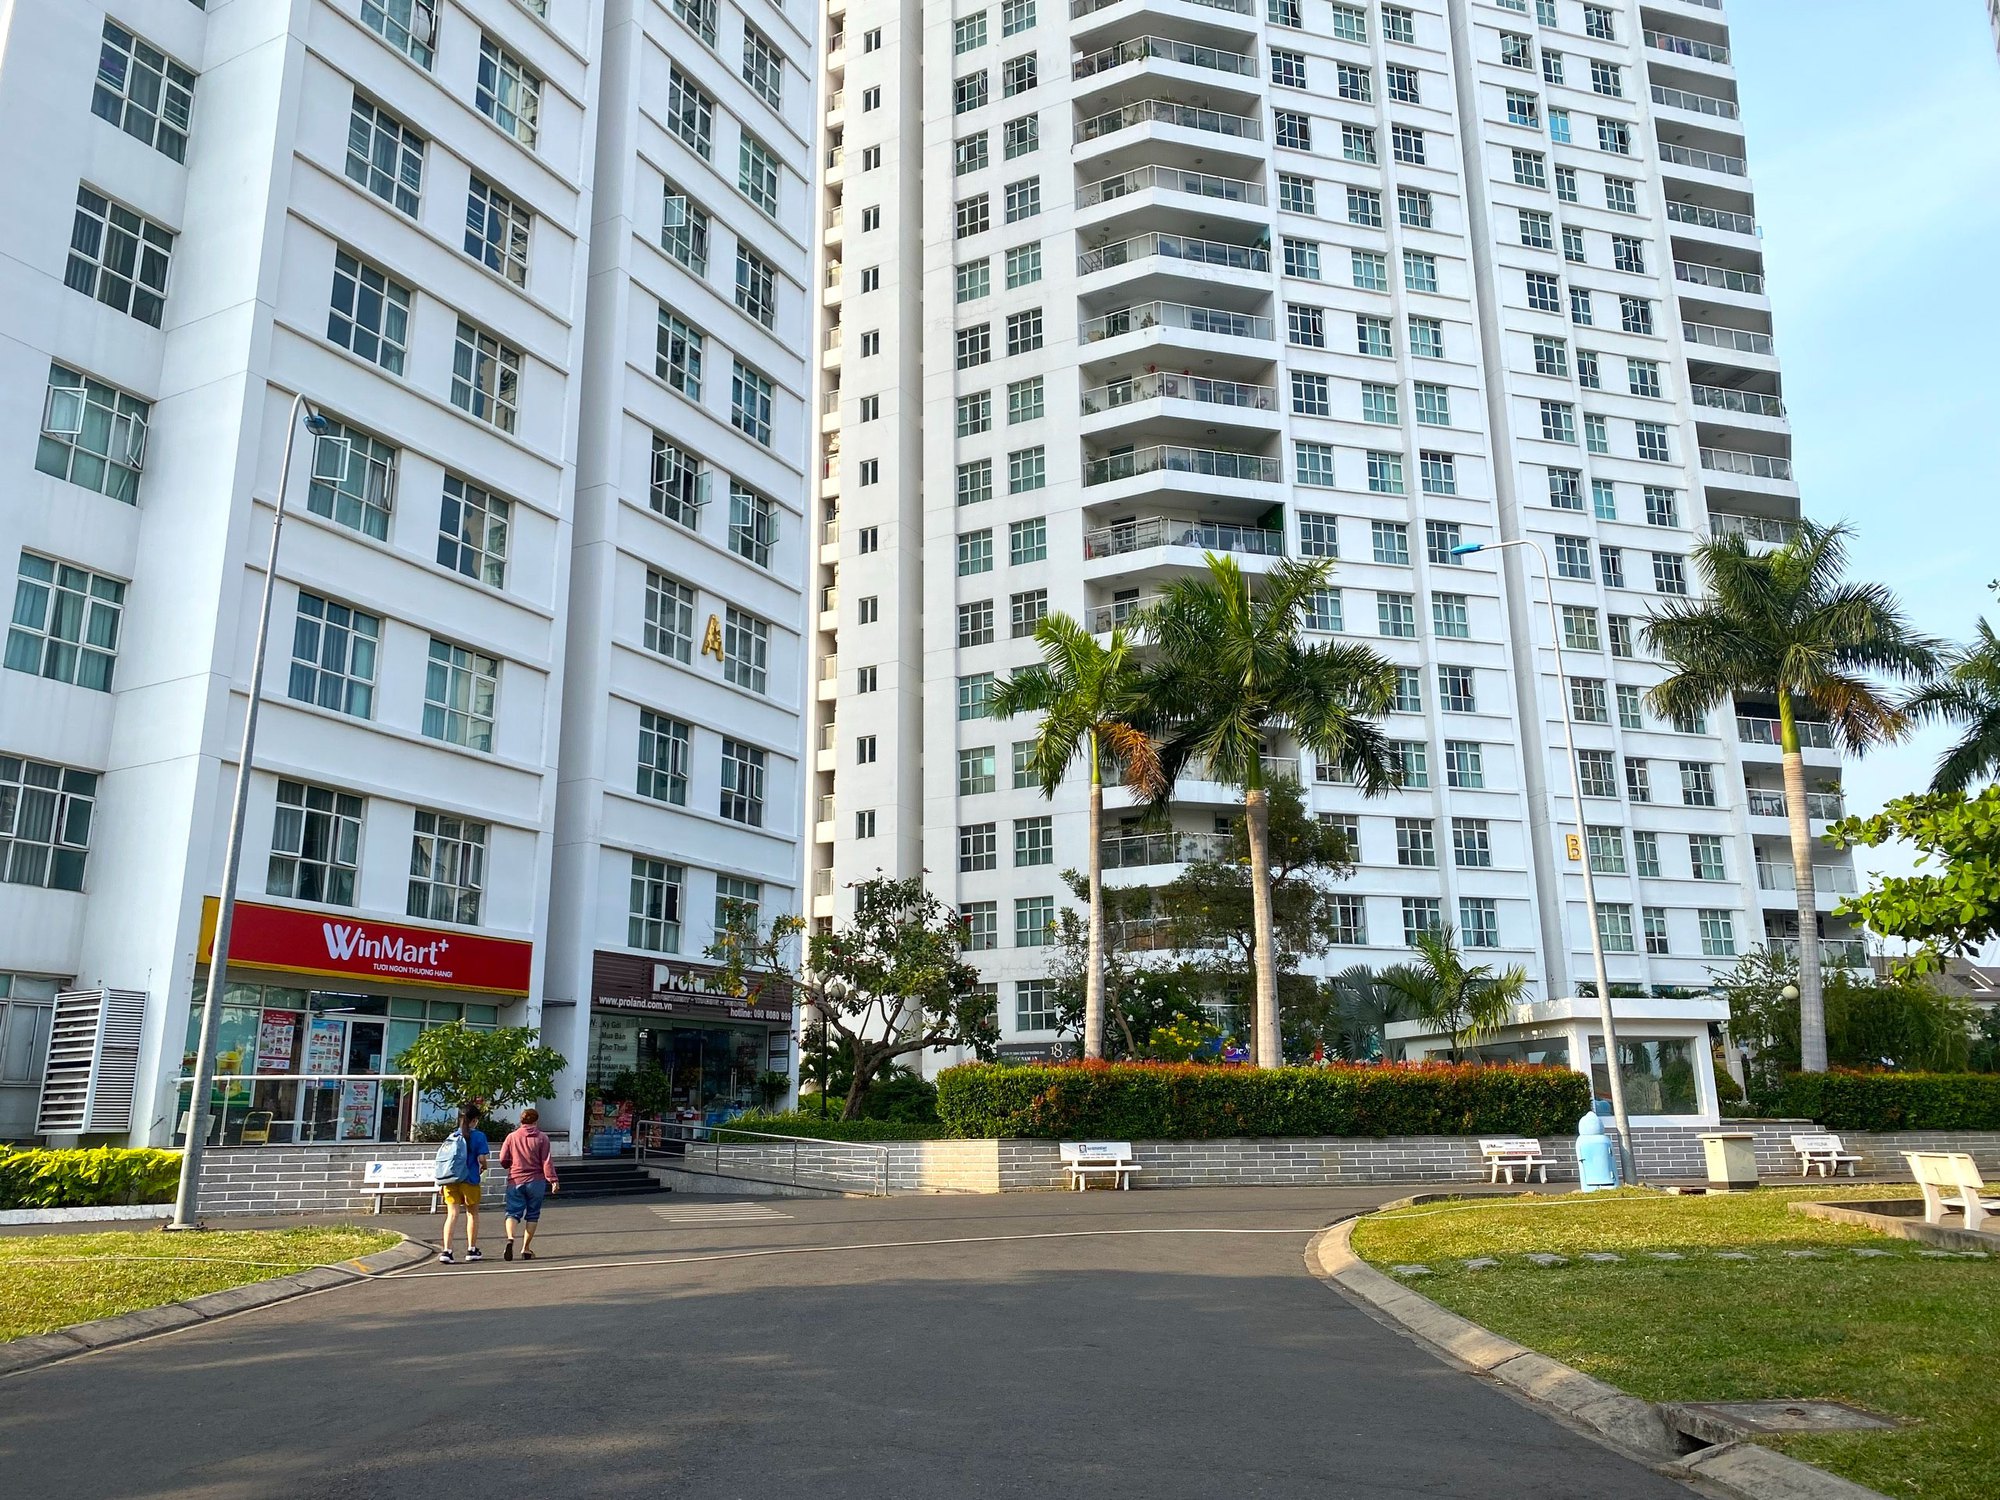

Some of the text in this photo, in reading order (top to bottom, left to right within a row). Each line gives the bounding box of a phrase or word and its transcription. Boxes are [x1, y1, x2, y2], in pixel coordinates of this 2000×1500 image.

[701, 614, 724, 662] A
[1566, 834, 1581, 861] B
[599, 996, 673, 1011] www.proland.com.vn
[730, 1007, 753, 1018] hotline:
[1050, 1043, 1063, 1058] 18
